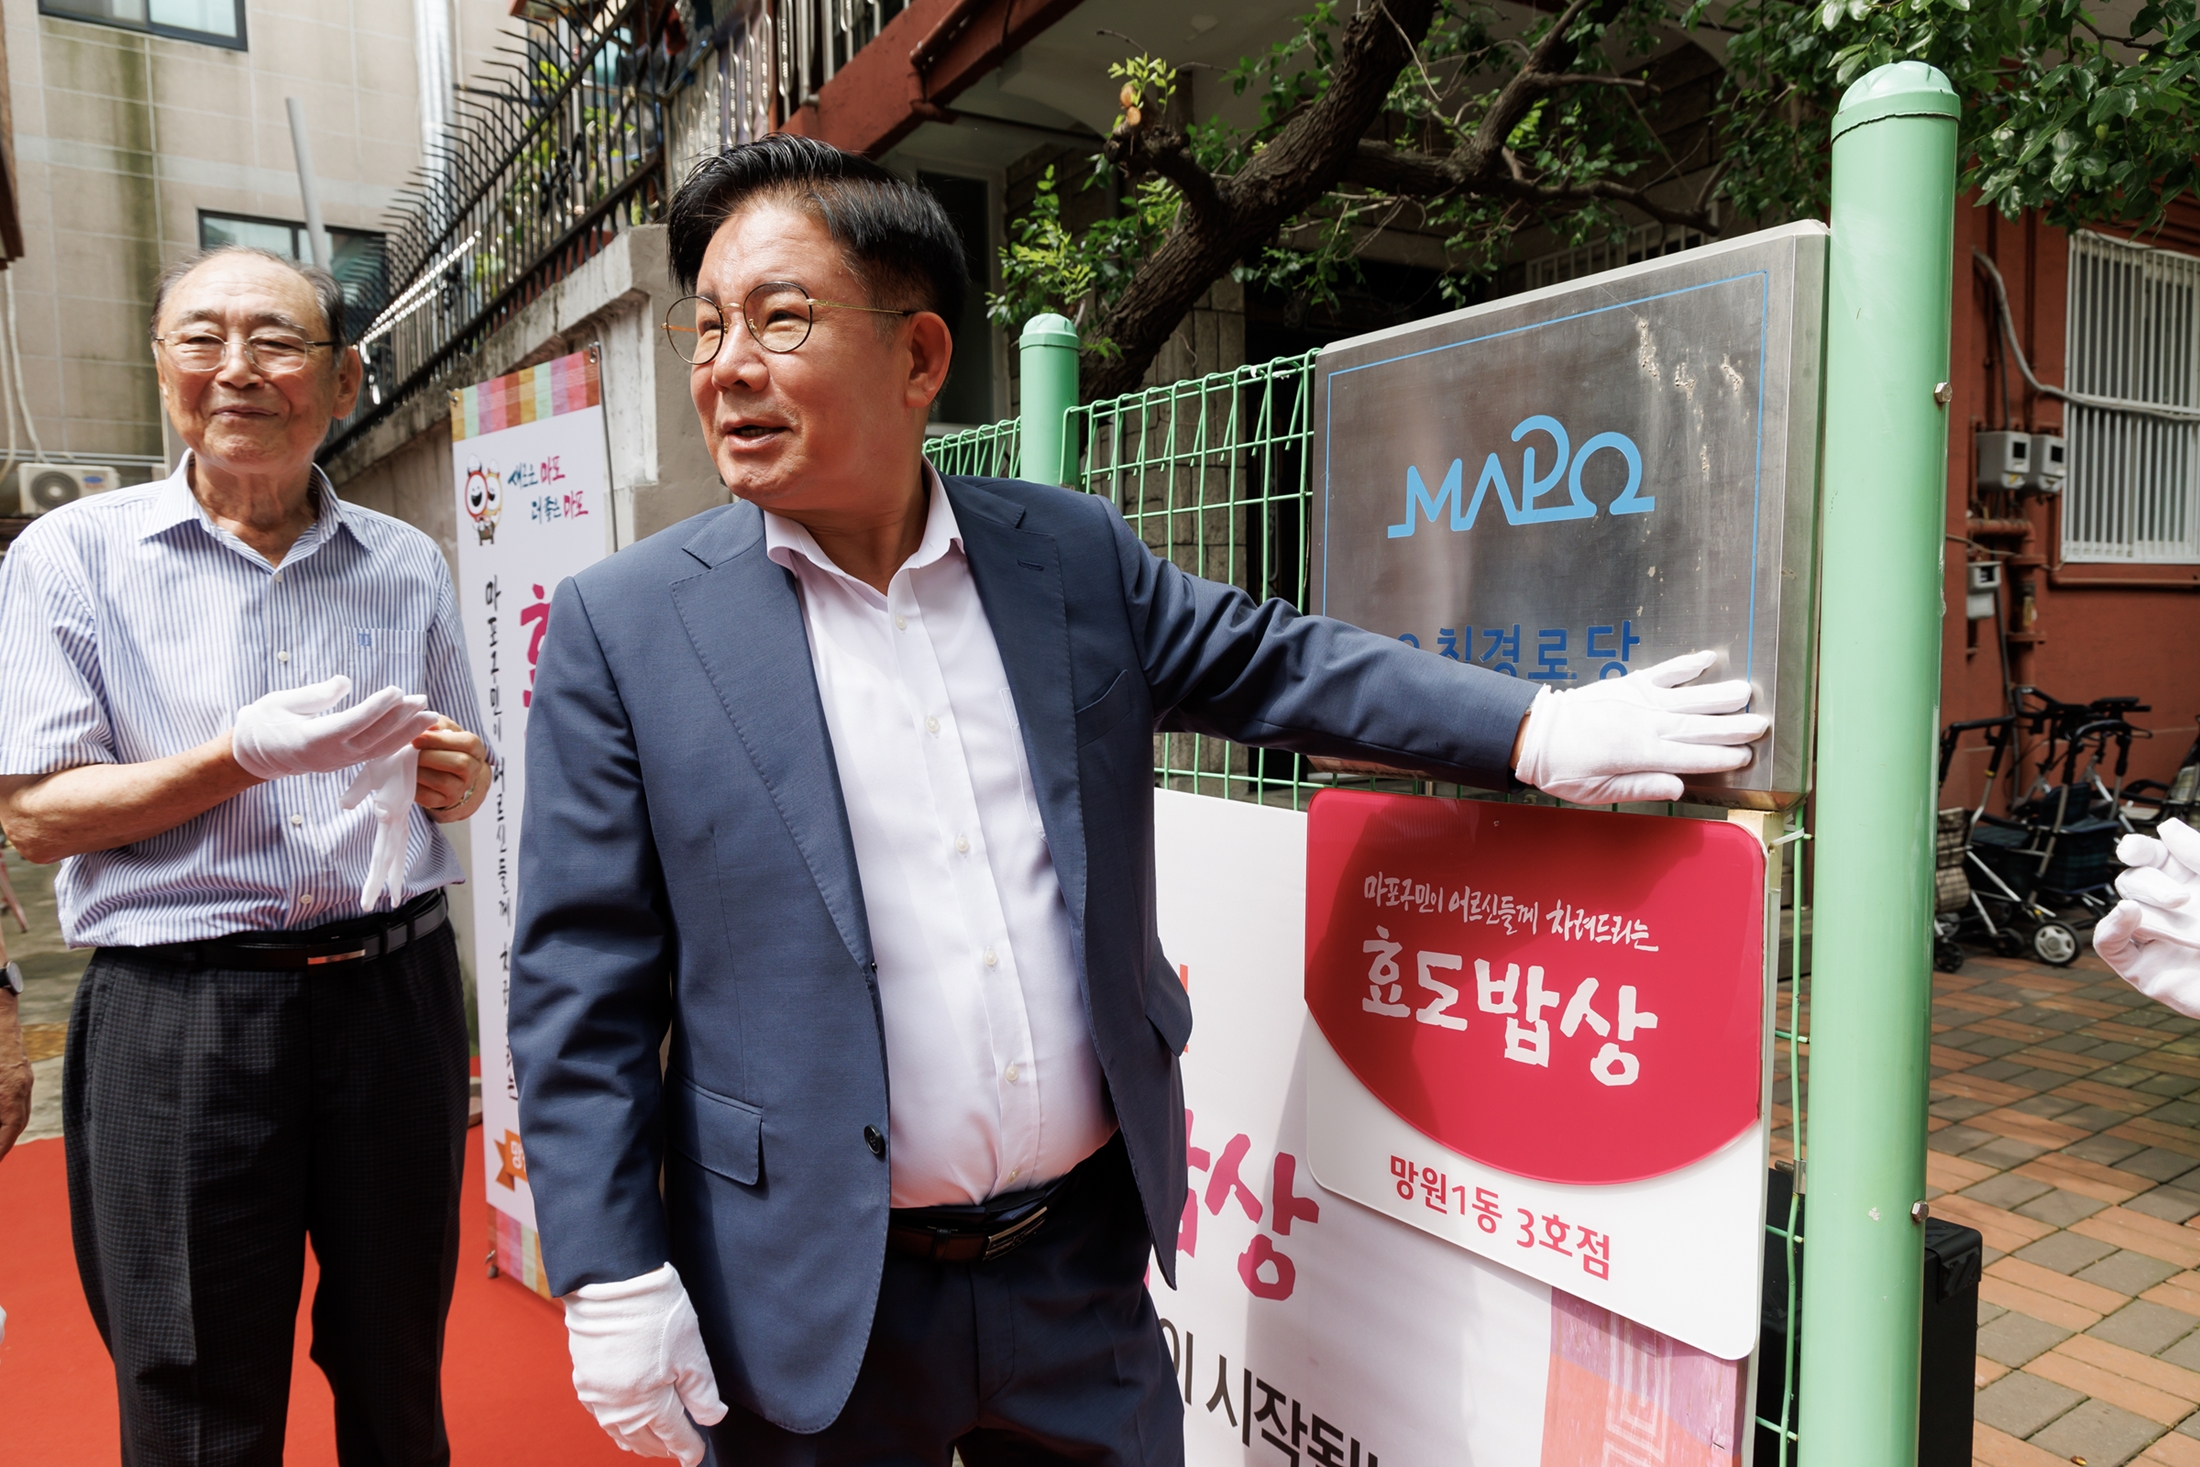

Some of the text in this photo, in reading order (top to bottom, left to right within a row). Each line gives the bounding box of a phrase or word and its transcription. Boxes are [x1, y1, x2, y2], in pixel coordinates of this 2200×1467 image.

[540, 455, 565, 485] 마포
[543, 496, 562, 522] 좋은
[563, 490, 588, 520] 마포
[1388, 415, 1655, 538] MAPO
[1364, 871, 1659, 952] 마포구민이 어르신들께 차려드리는
[1362, 925, 1658, 1086] 효도밥상
[1390, 1154, 1610, 1281] 망원1동 3호점
[1205, 1353, 1379, 1467] 시작됩
